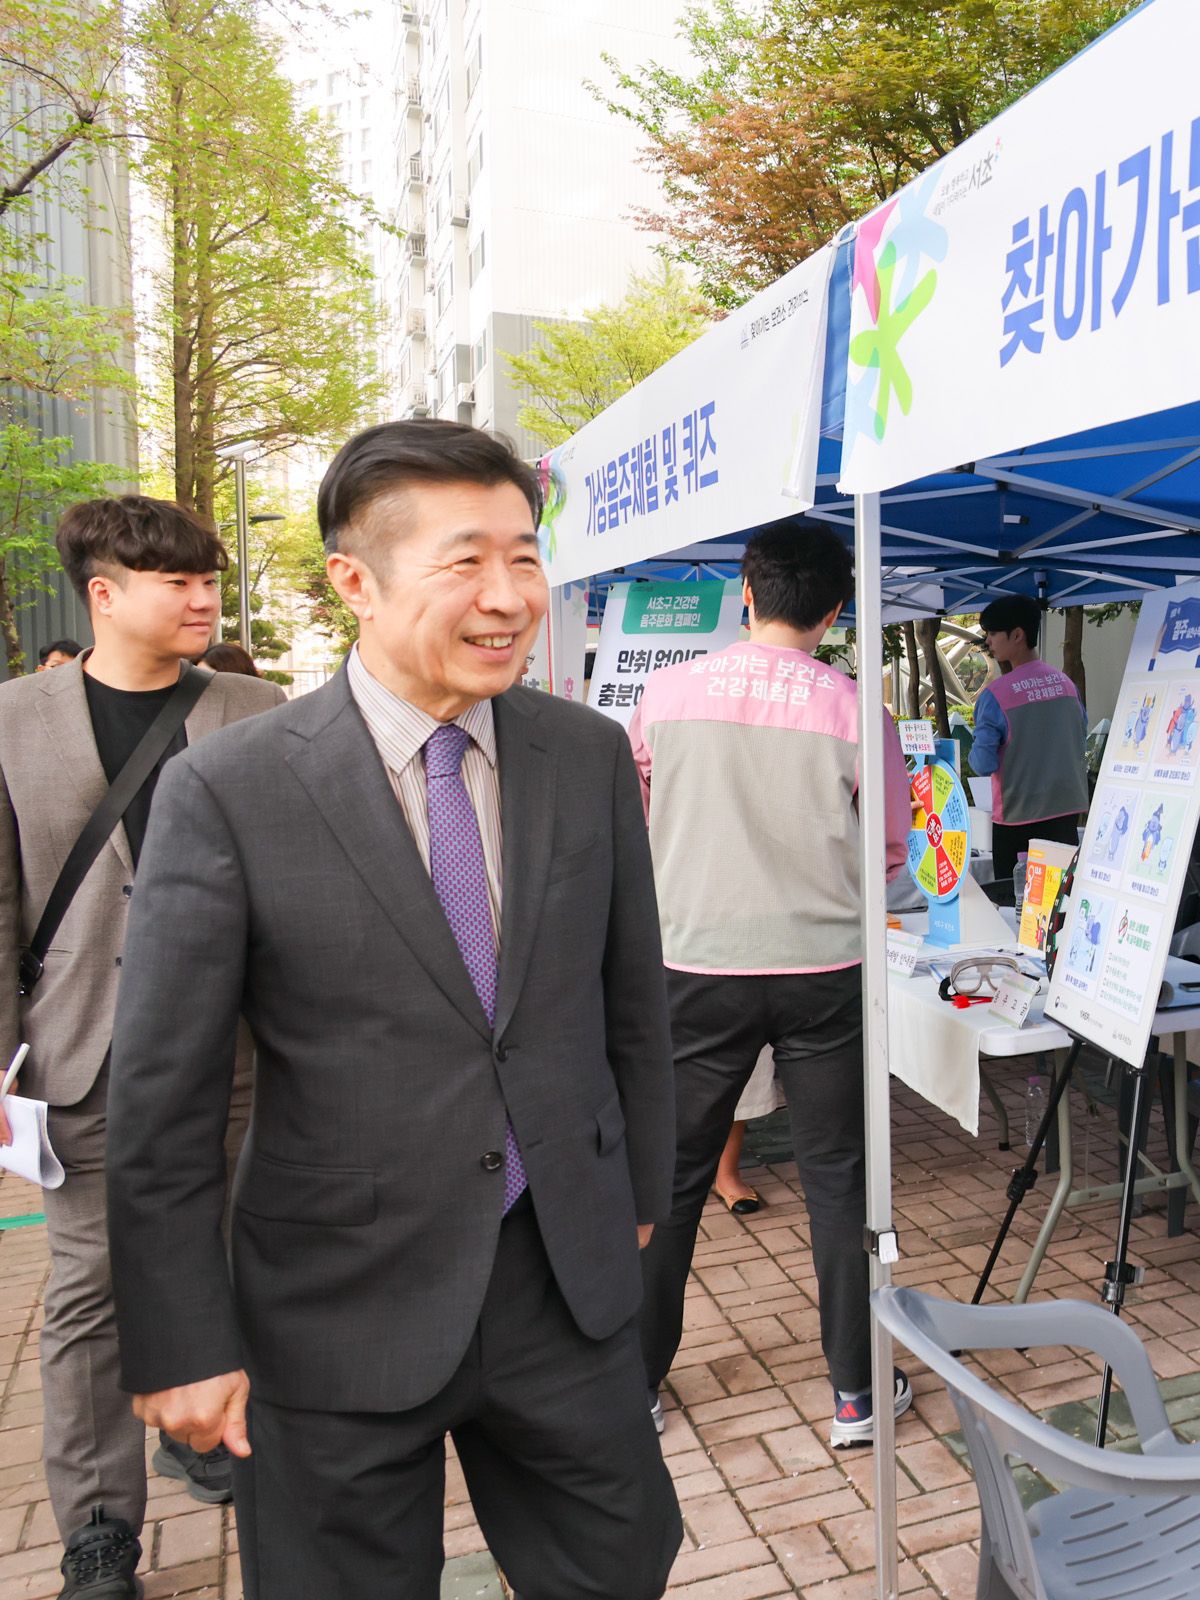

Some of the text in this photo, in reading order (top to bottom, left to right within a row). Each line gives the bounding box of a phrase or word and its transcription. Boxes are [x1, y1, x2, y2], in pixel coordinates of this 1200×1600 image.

[969, 150, 994, 190] 서초
[771, 304, 786, 327] 보건소
[585, 400, 719, 536] 가상음주체험 및 퀴즈
[646, 595, 700, 610] 서초구 건강한
[640, 613, 701, 628] 음주문화 캠페인
[617, 649, 652, 673] 만취
[688, 654, 836, 690] 찾아가는 보건소
[707, 676, 812, 706] 건강체험관
[1012, 677, 1045, 693] 찾아가는
[1027, 685, 1063, 701] 건강체험관
